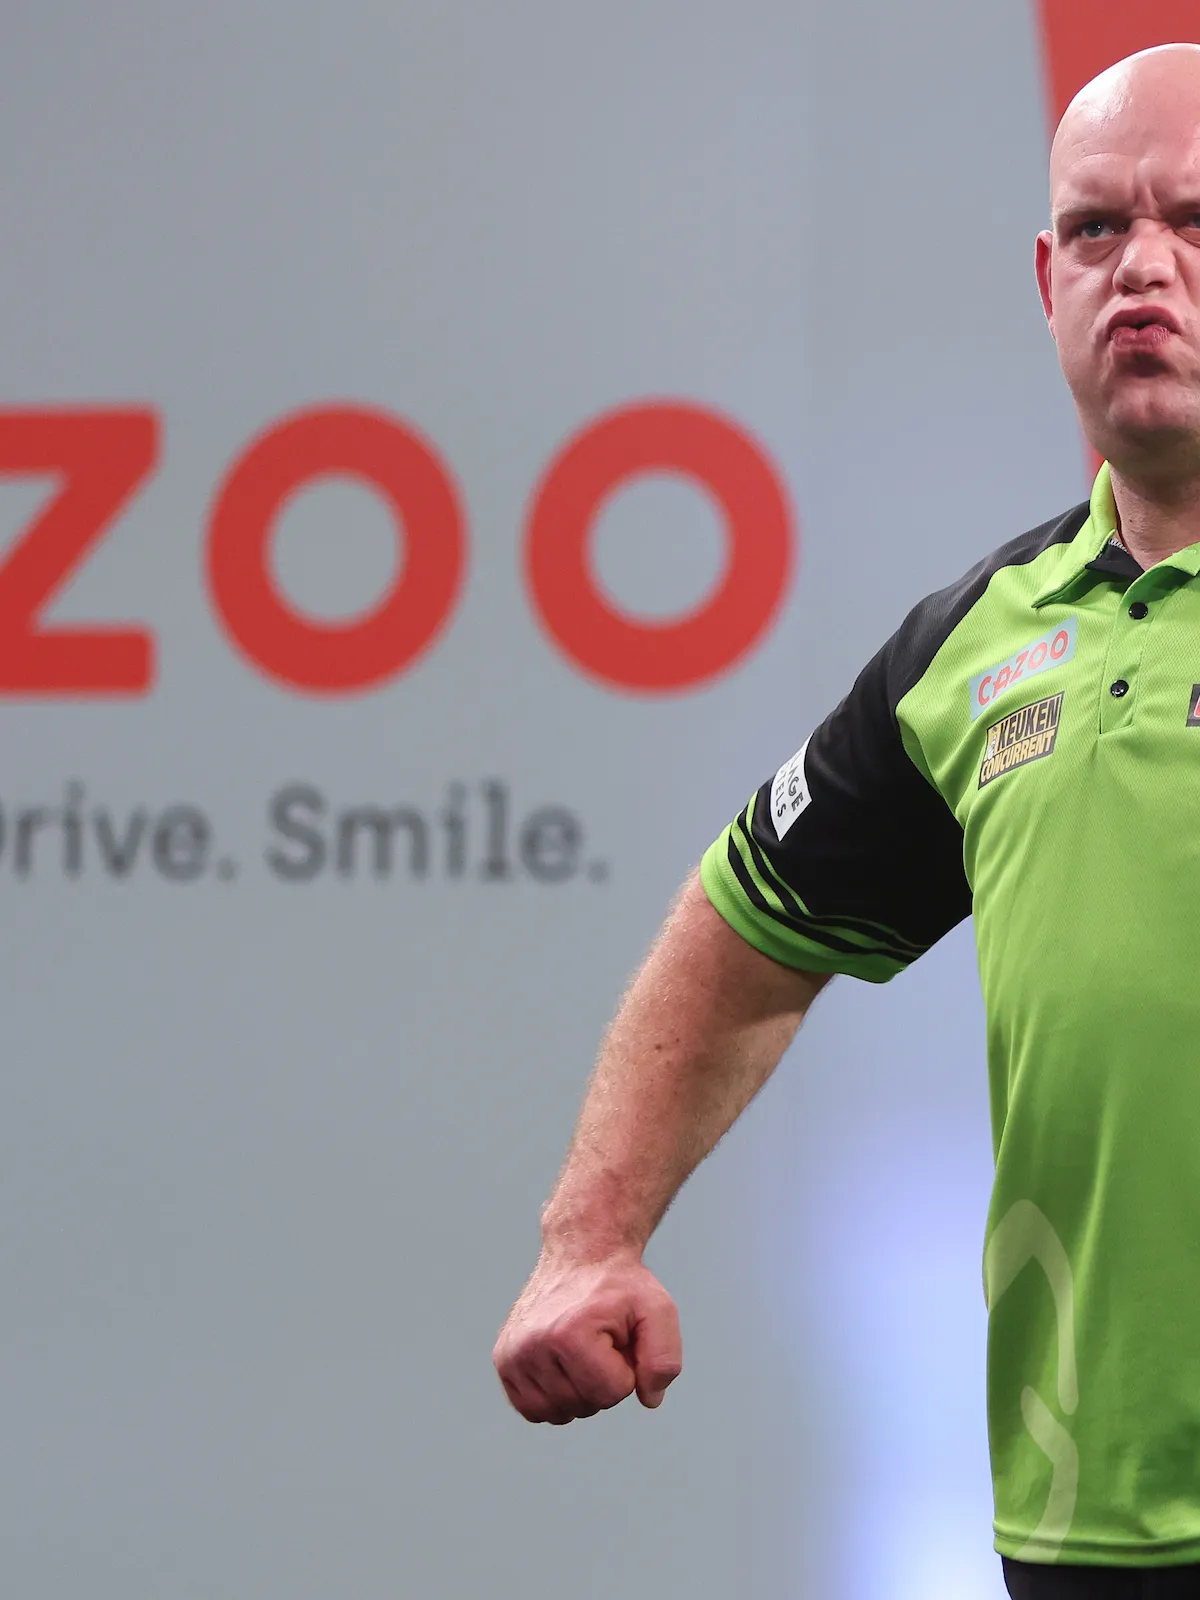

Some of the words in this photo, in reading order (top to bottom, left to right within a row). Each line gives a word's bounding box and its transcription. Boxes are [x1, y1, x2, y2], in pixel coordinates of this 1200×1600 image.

[978, 630, 1068, 706] CAZOO
[980, 729, 1055, 783] CONCURRENT
[997, 697, 1060, 750] KEUKEN
[0, 777, 239, 883] rive.
[265, 780, 608, 885] Smile.
